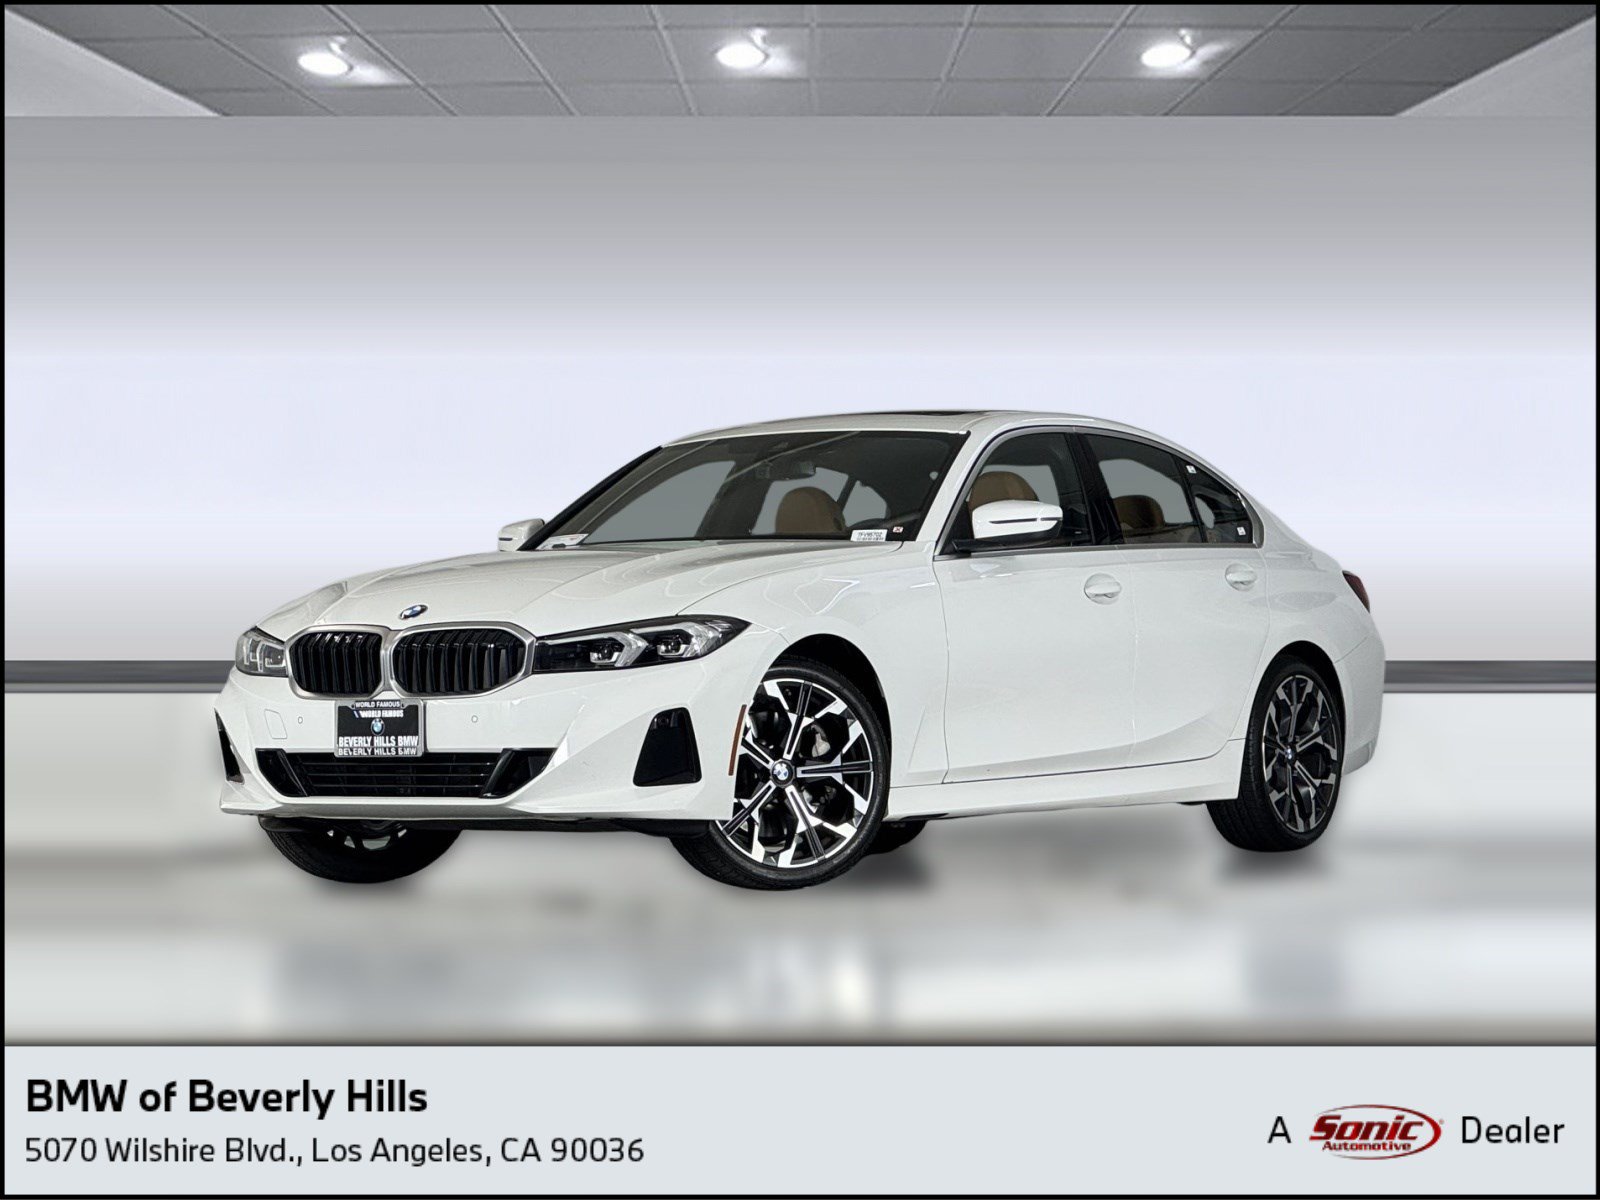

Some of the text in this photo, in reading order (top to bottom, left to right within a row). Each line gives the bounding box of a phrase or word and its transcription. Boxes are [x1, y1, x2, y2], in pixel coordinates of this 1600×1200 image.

[382, 710, 404, 718] FAMOUS
[338, 736, 418, 747] BEVERLY HILLS BMW
[338, 748, 417, 756] BEVERLY HILLS BMW
